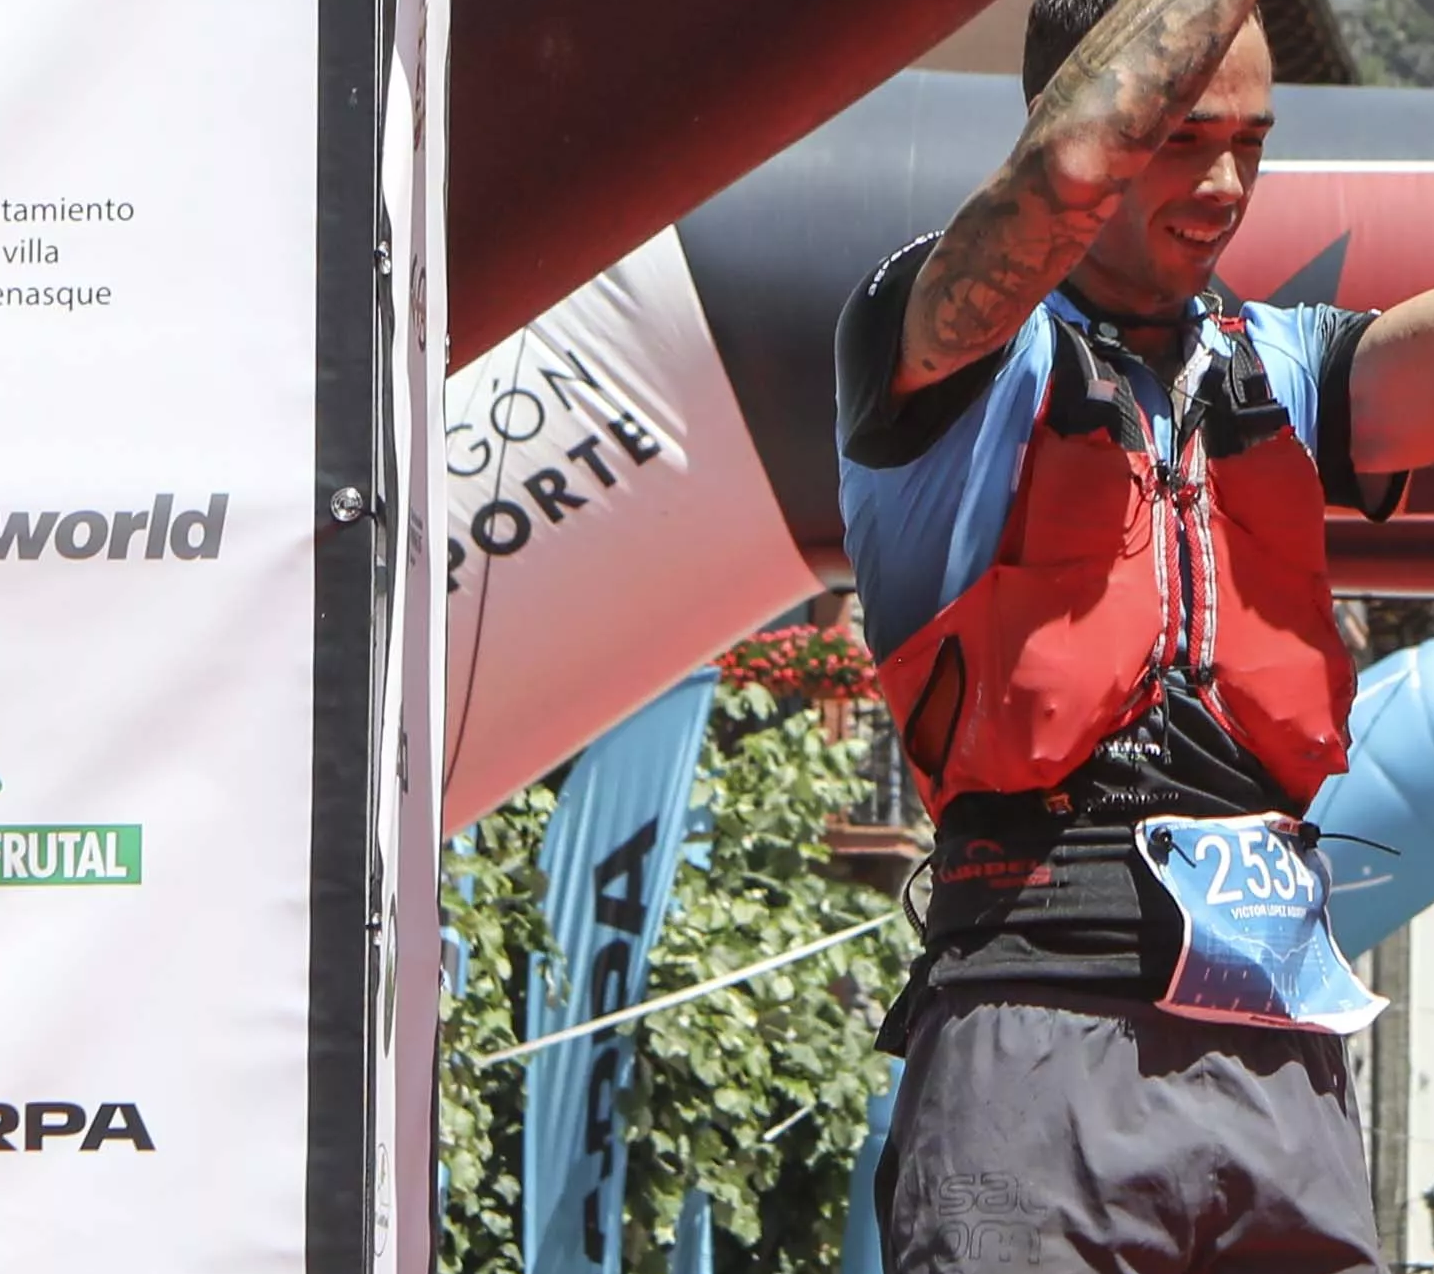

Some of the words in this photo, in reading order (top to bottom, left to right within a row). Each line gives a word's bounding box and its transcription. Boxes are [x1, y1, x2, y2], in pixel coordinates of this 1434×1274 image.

[2, 239, 60, 265] villa
[1194, 830, 1314, 905] 2534
[1230, 904, 1266, 920] VICTOR
